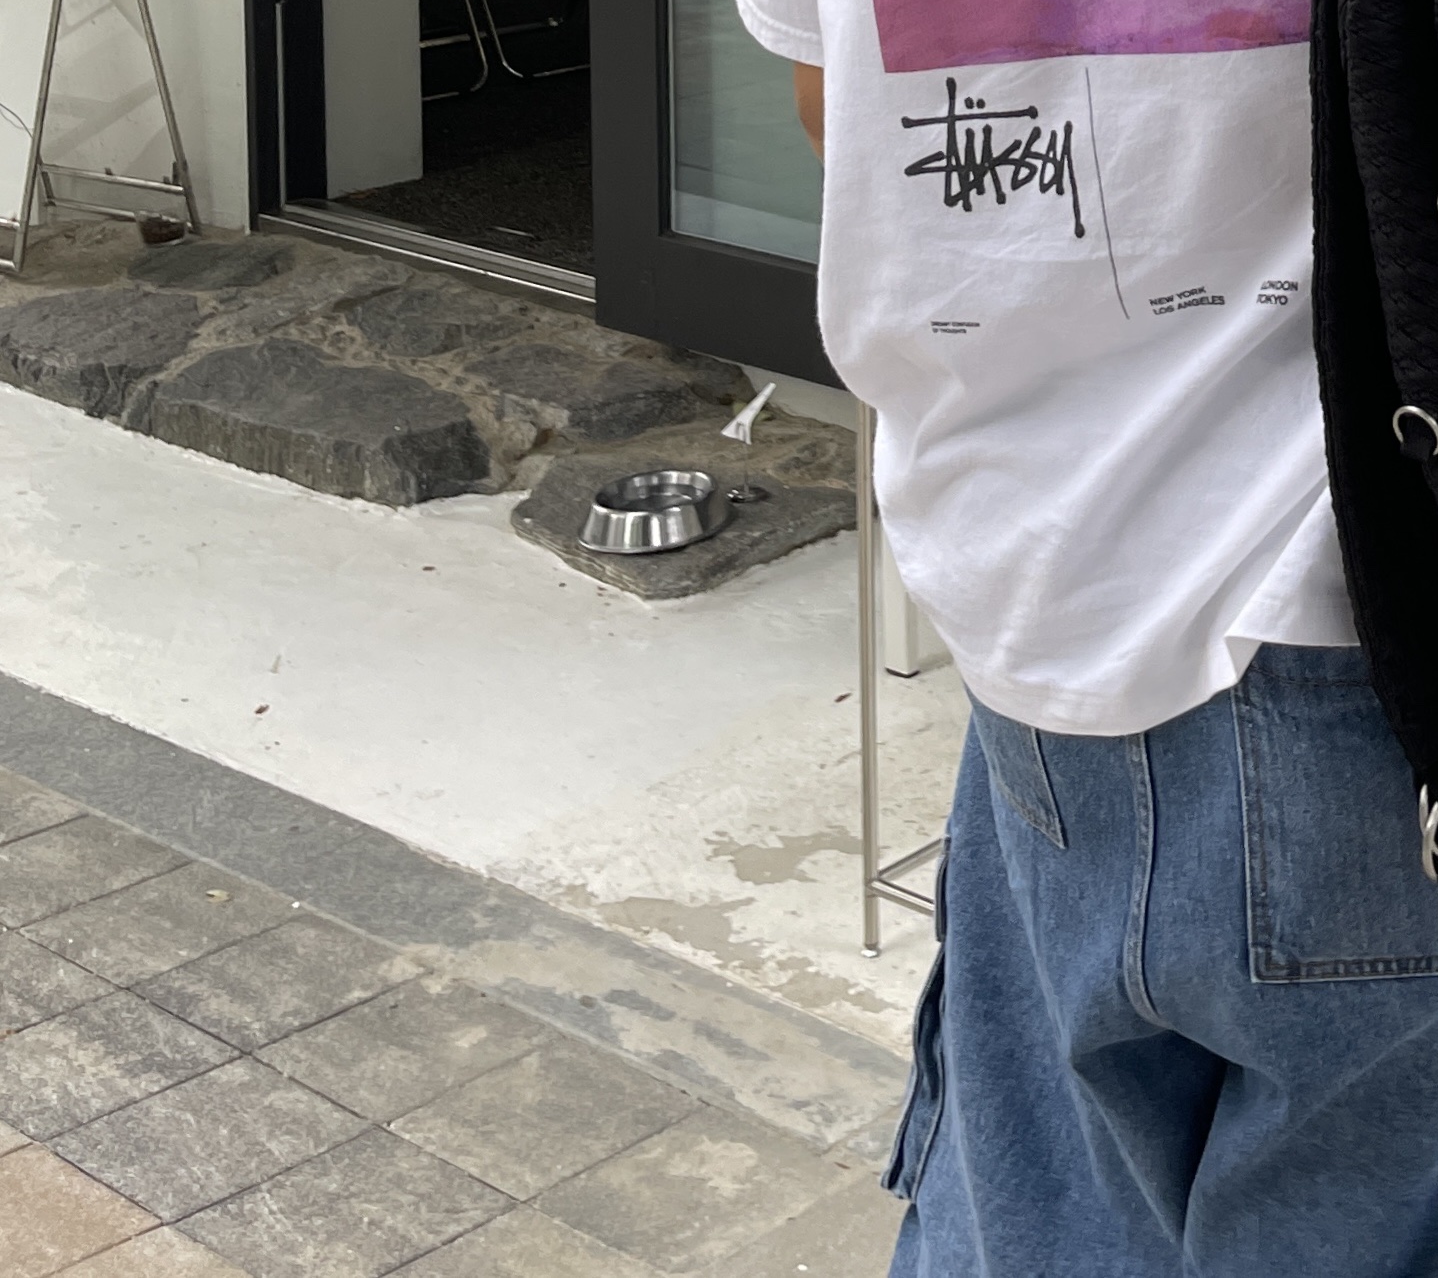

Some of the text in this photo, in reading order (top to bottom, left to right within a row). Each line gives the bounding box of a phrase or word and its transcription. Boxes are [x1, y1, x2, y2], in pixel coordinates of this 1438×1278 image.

[1150, 286, 1207, 307] NEW YORK
[1153, 295, 1226, 316] LOS ANGELES
